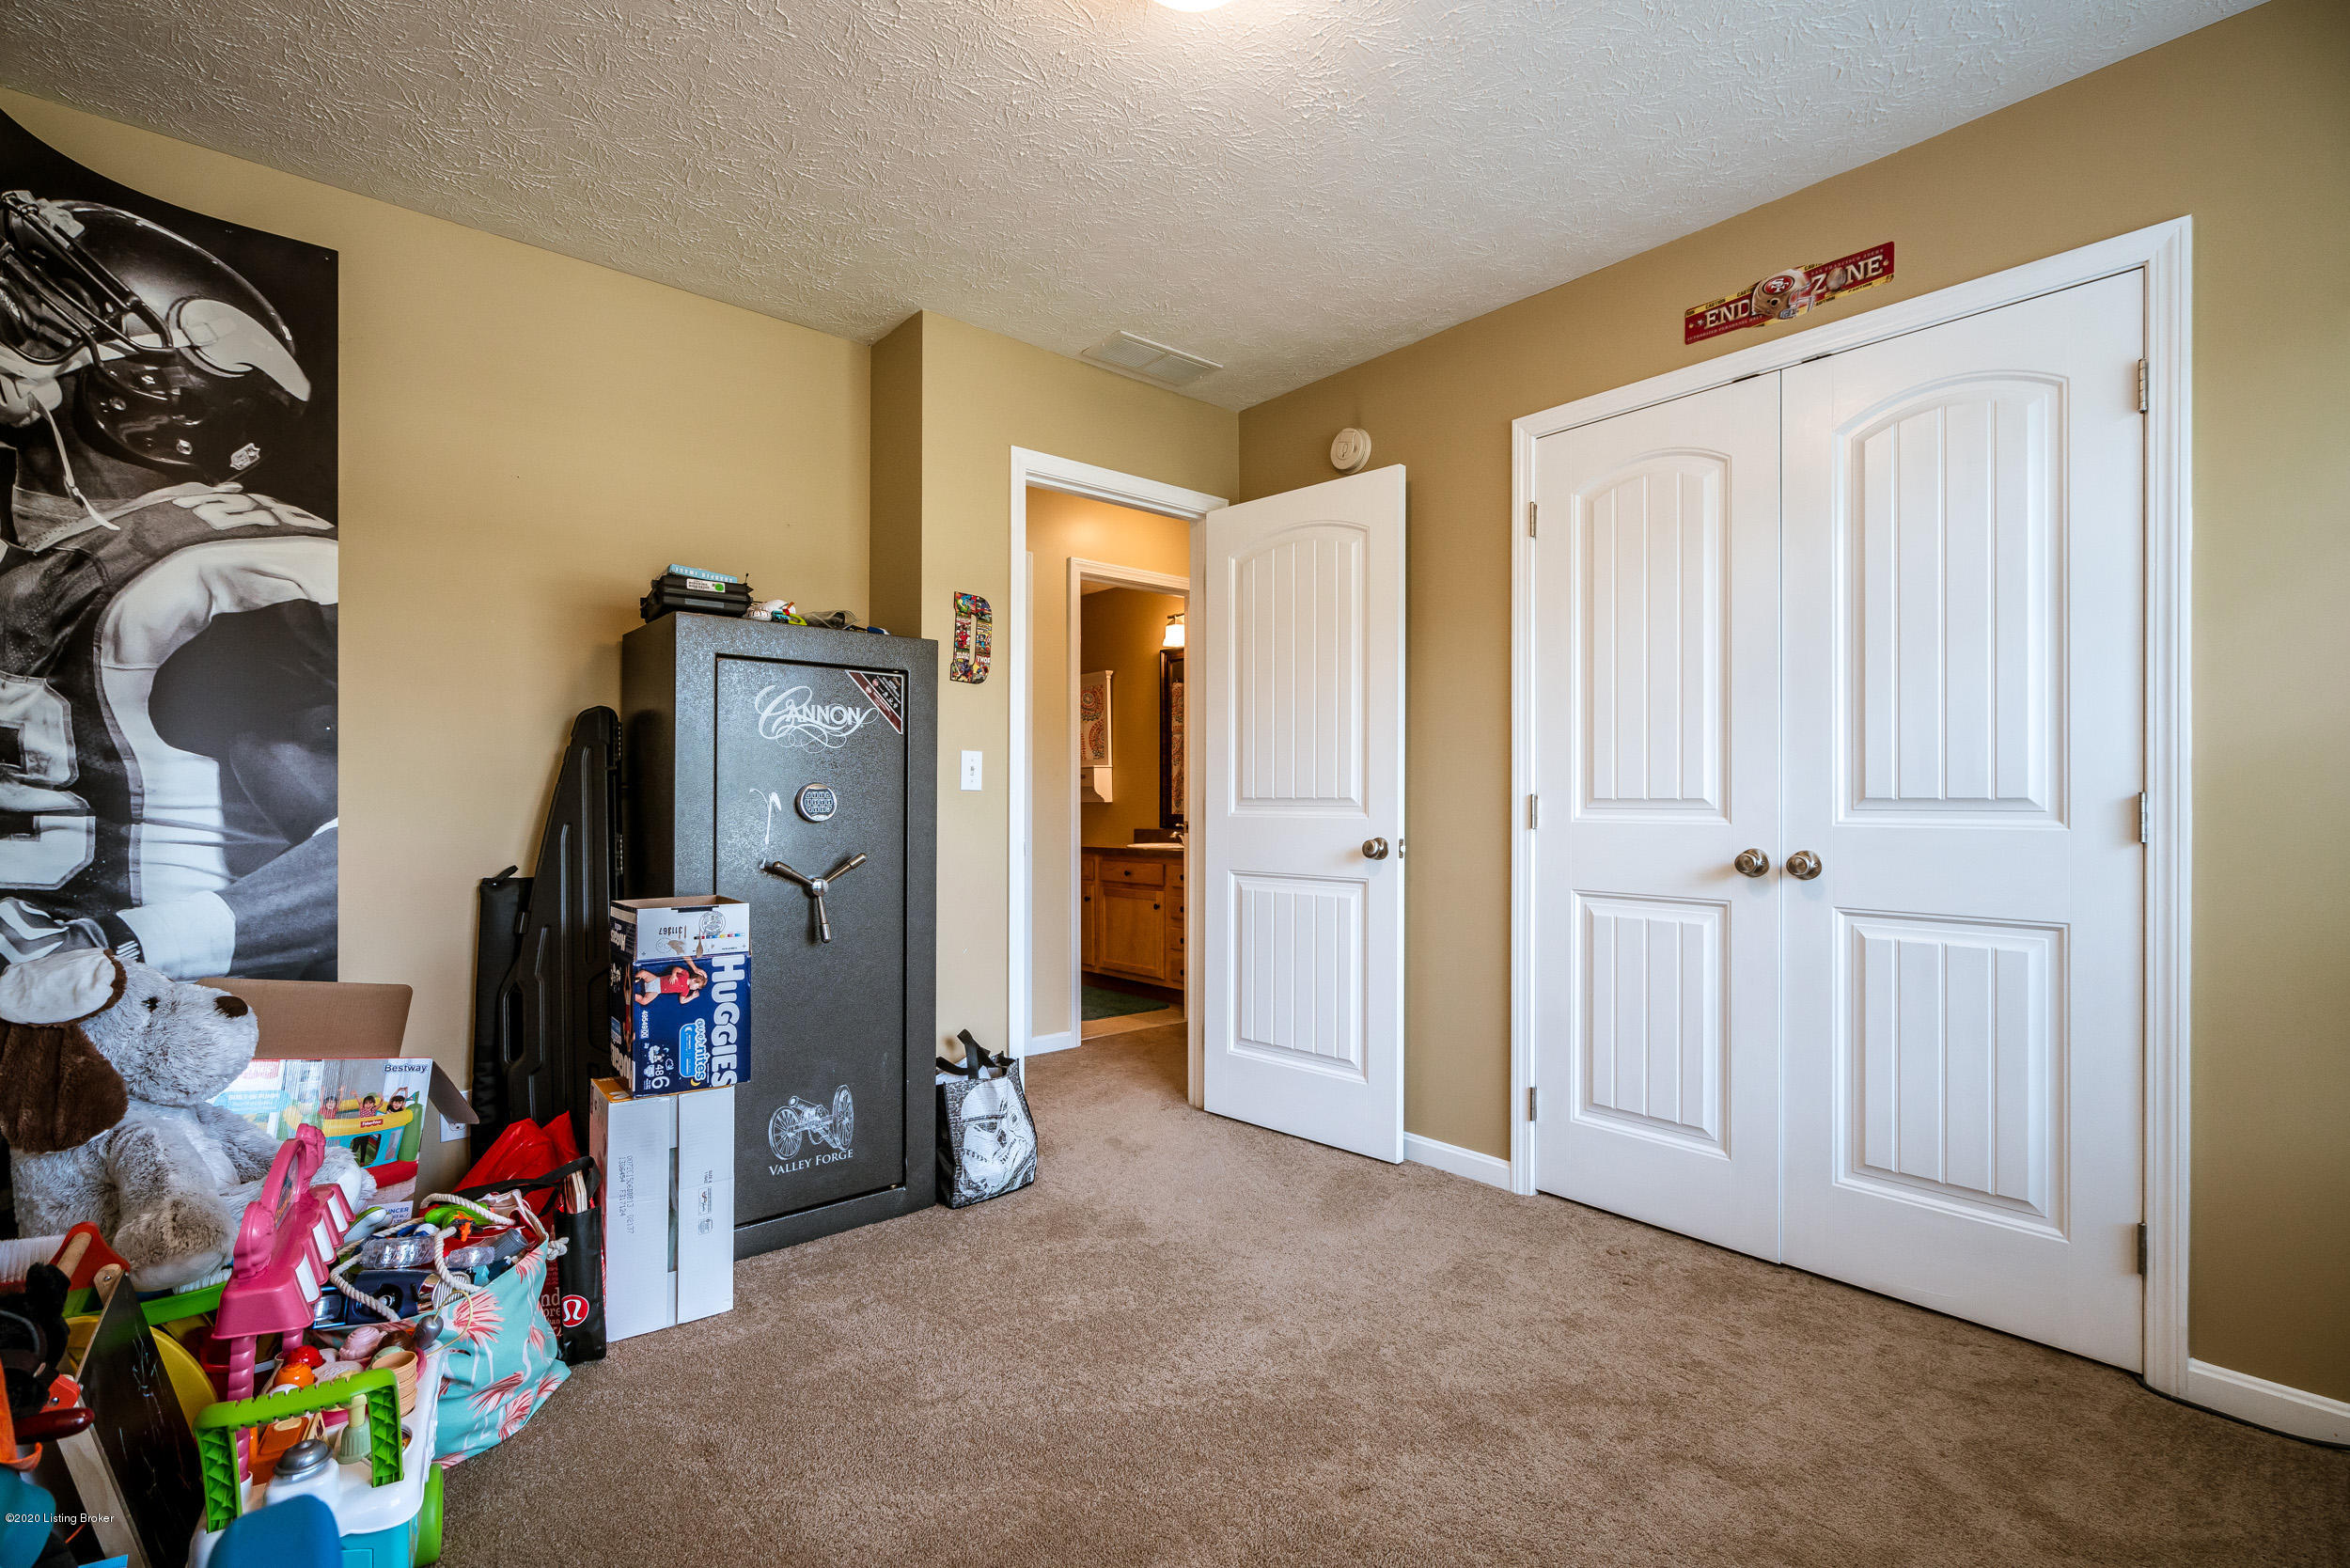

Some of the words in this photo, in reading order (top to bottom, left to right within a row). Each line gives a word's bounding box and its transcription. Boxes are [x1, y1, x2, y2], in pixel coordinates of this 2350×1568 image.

[1703, 299, 1751, 329] END
[755, 685, 879, 745] CANNON
[712, 954, 744, 1088] HUGGIES
[696, 1019, 707, 1080] overnites
[384, 1063, 428, 1073] Bestway
[655, 1064, 664, 1076] 48
[651, 1075, 670, 1090] 6
[768, 1158, 813, 1176] VALLEY
[815, 1149, 854, 1166] FORGE
